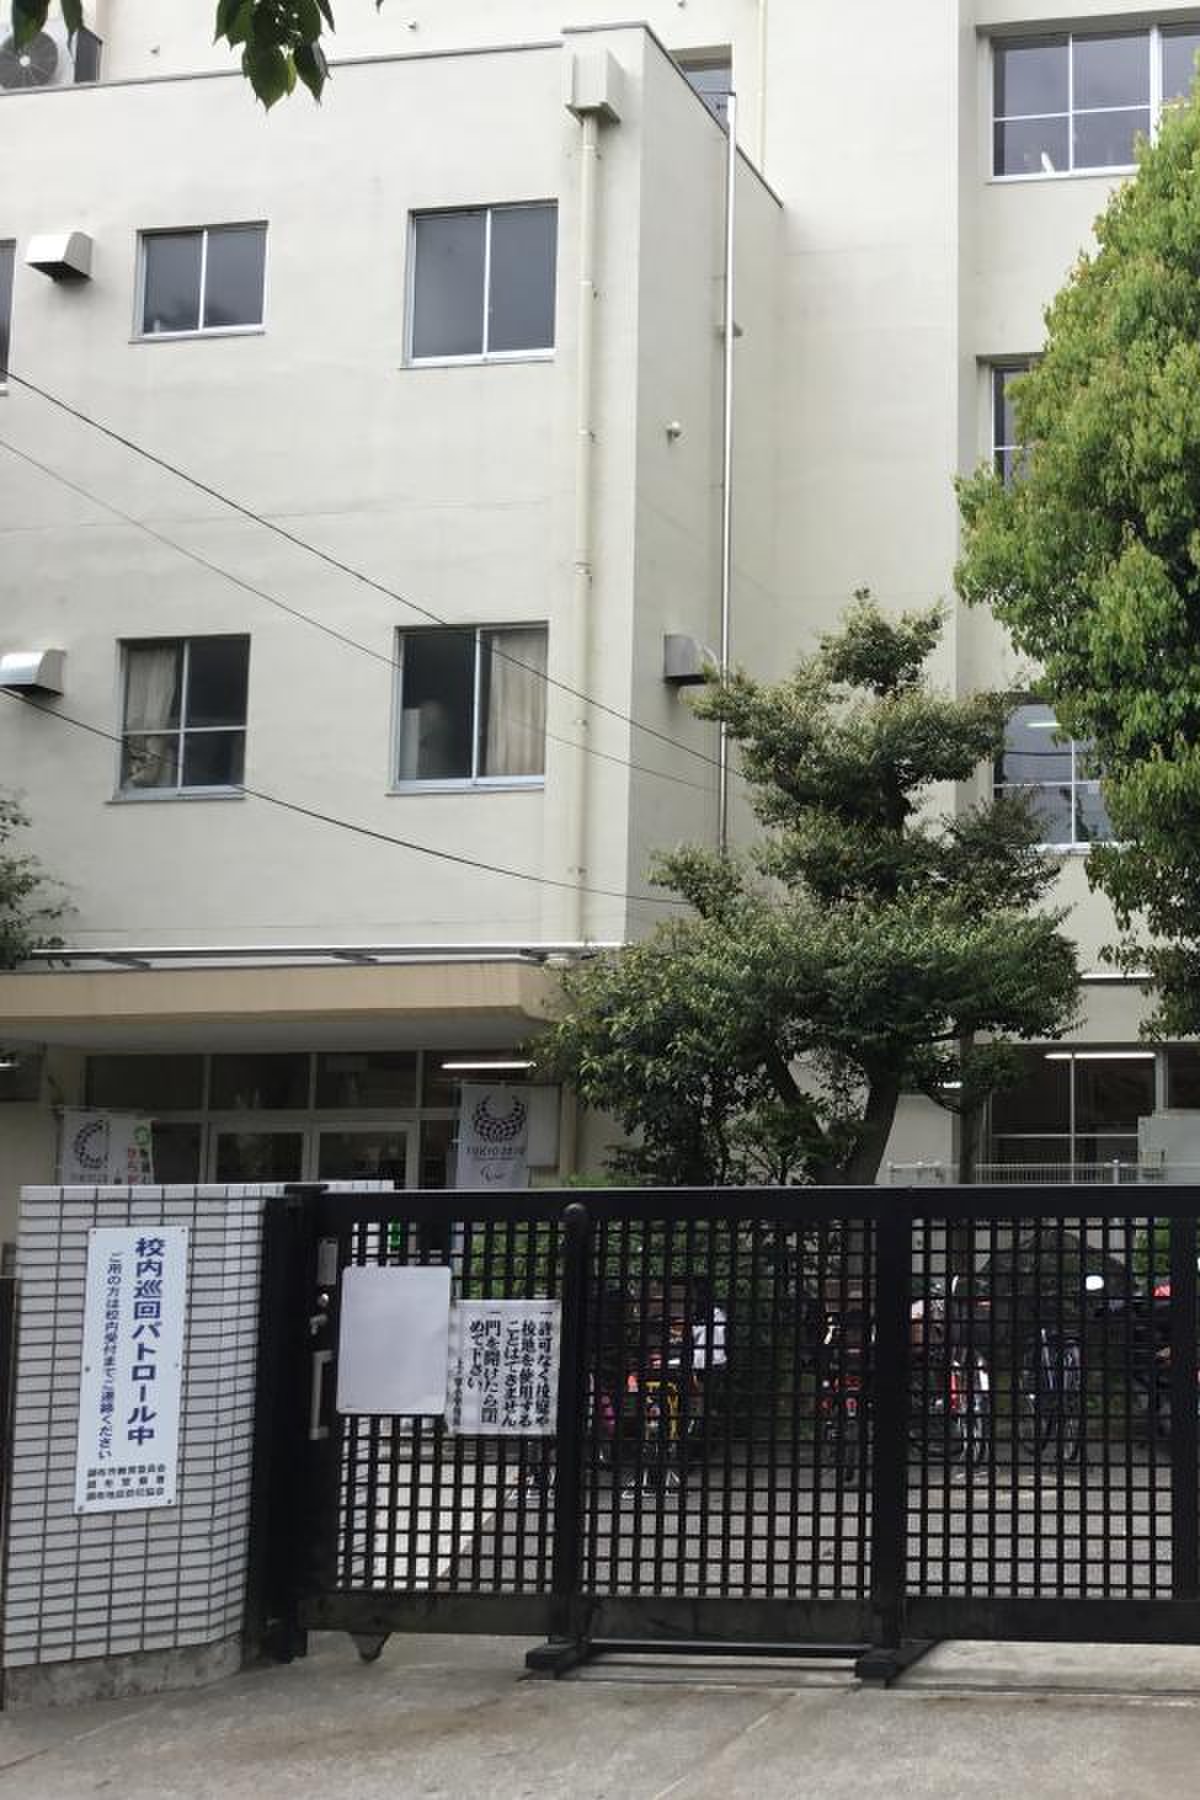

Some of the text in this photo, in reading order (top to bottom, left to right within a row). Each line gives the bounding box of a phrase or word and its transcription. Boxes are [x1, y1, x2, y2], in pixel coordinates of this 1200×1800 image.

[127, 1237, 166, 1447] 校内巡回パトロール中
